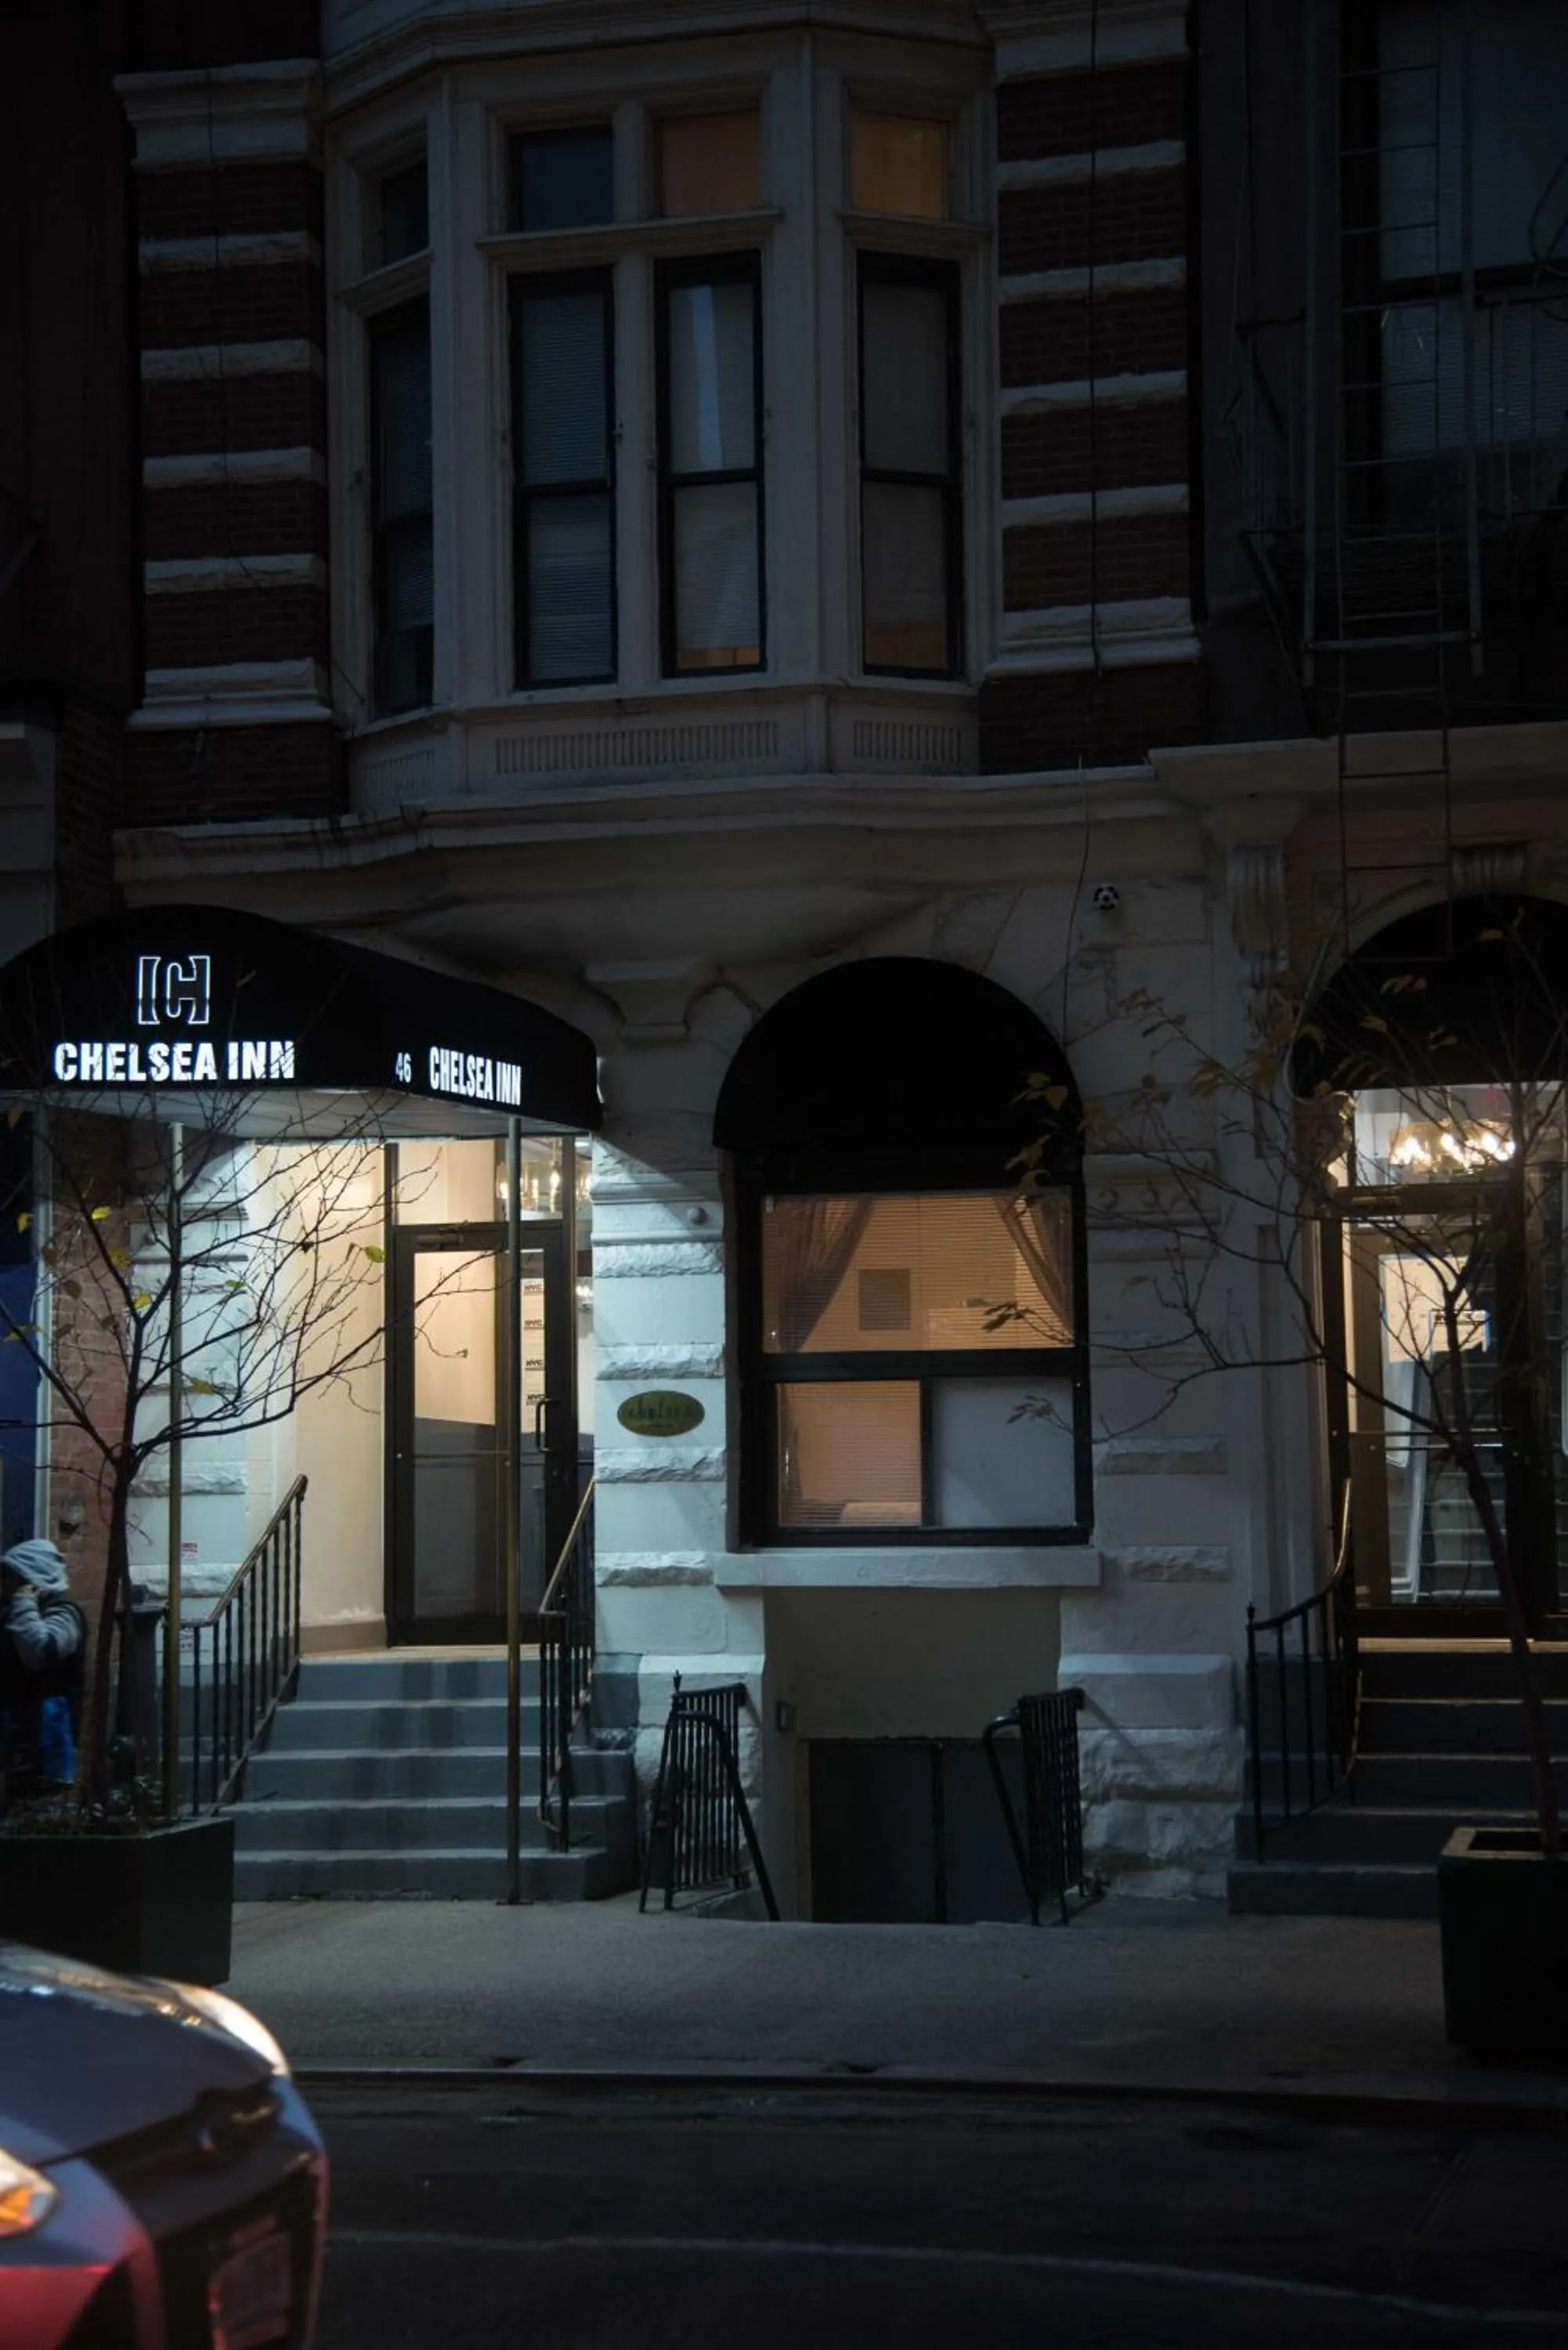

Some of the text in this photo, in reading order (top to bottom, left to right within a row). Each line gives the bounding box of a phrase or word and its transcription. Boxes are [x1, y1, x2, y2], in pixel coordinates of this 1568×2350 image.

[53, 1040, 296, 1082] CHELSEA INN
[395, 1045, 522, 1107] 46 CHELSEA INN
